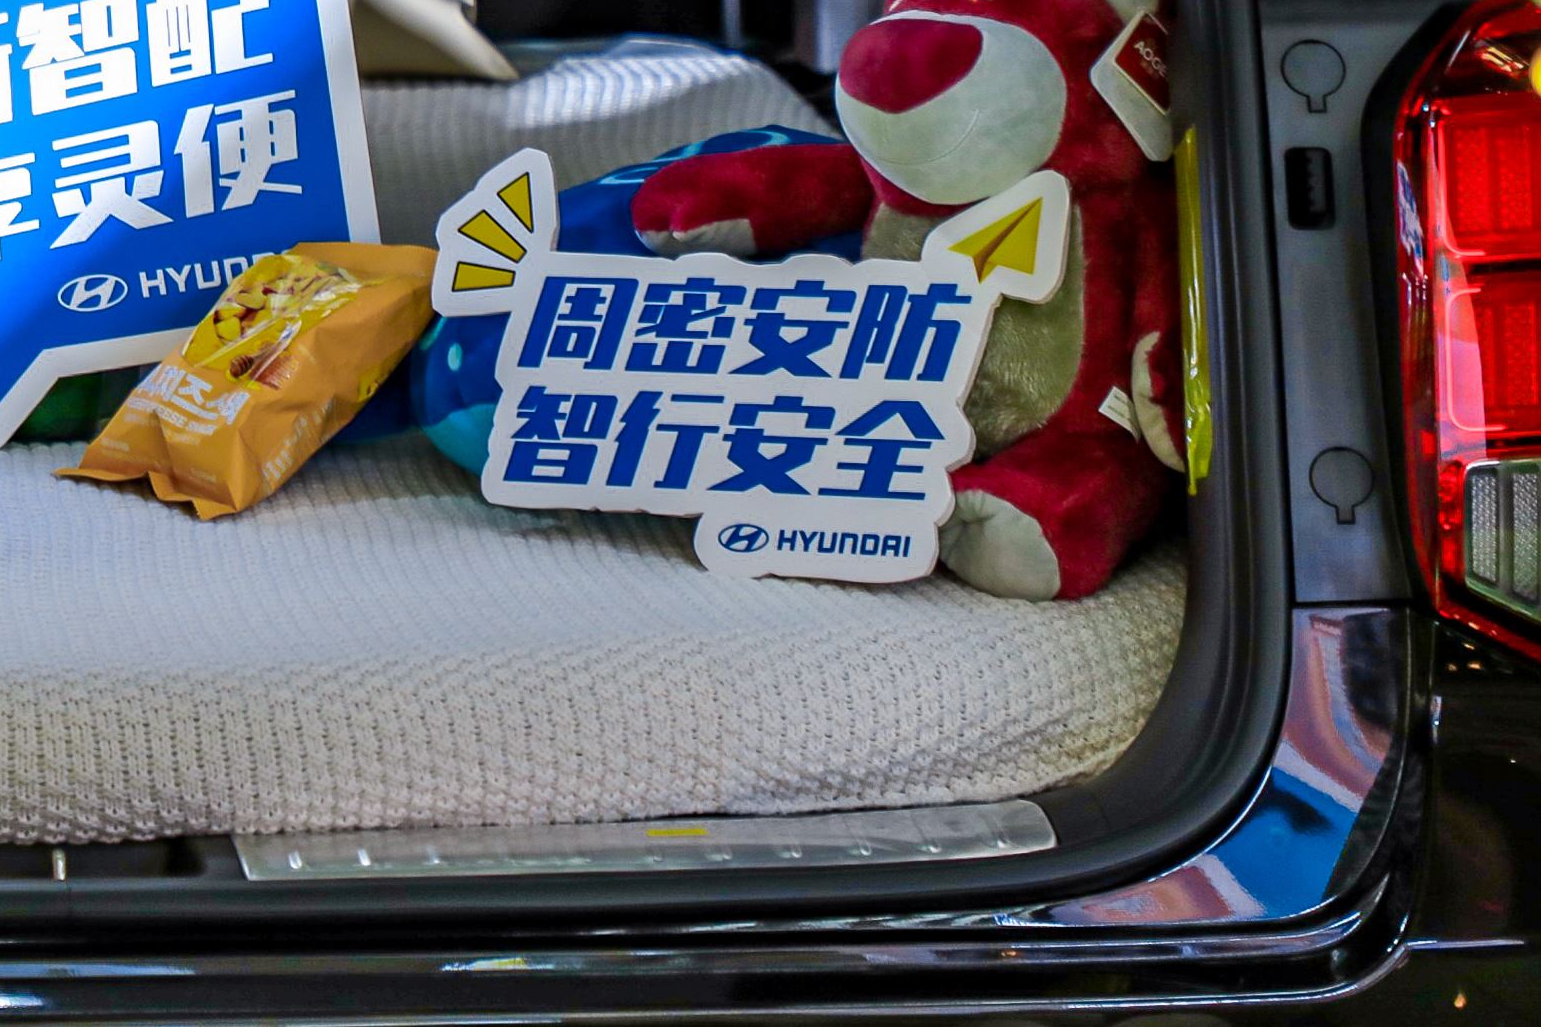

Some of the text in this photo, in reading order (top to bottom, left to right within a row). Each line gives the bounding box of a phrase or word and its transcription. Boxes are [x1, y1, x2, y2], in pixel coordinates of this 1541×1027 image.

[139, 250, 288, 298] HYUN
[517, 276, 972, 382] 周密安防
[502, 385, 945, 501] 智行安全
[777, 528, 911, 559] HYUNDAI
